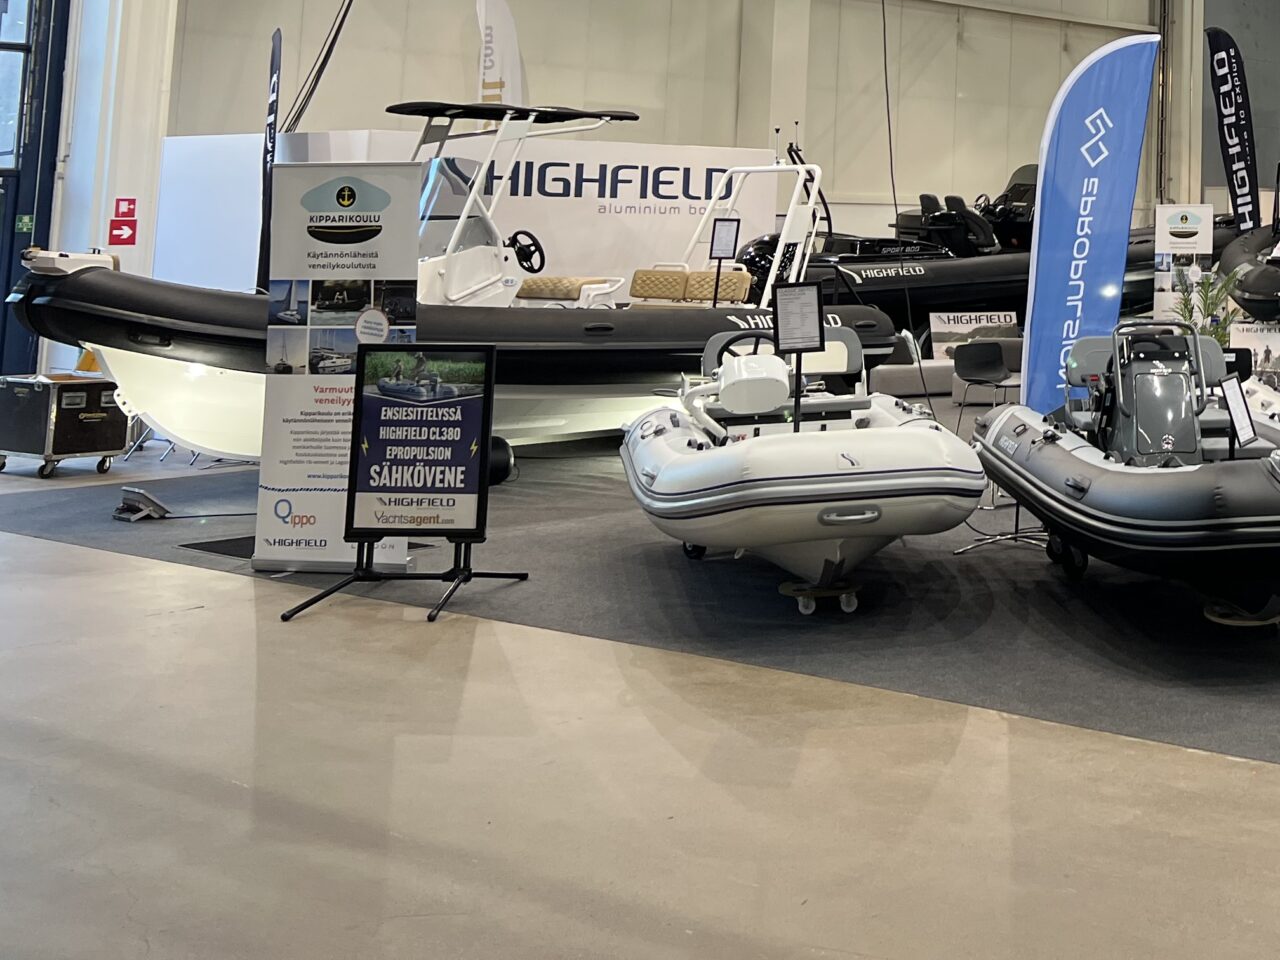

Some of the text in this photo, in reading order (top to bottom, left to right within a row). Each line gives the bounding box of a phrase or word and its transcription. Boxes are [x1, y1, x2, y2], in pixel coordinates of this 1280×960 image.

[1213, 51, 1254, 230] HIGHFIELD
[483, 160, 734, 200] HIGHFIELD
[598, 204, 681, 215] aluminium
[309, 215, 380, 224] KIPPARIKOULU
[307, 251, 379, 262] Käytännönläheistä
[308, 261, 377, 270] veneilykoulutusta
[861, 266, 925, 279] HIGHFIELD
[946, 313, 1013, 325] HIGHFIELD
[313, 386, 355, 394] Varmuut
[381, 406, 462, 420] ENSIESITTELYSSÄ
[379, 427, 461, 440] HIGHFIELD CL380
[386, 446, 452, 460] EPROPULSION
[369, 462, 466, 488] SÄHKÖVENE
[388, 498, 455, 507] HIGHFIELD
[274, 499, 316, 528] Qippo
[273, 539, 327, 548] HIGHFIELD
